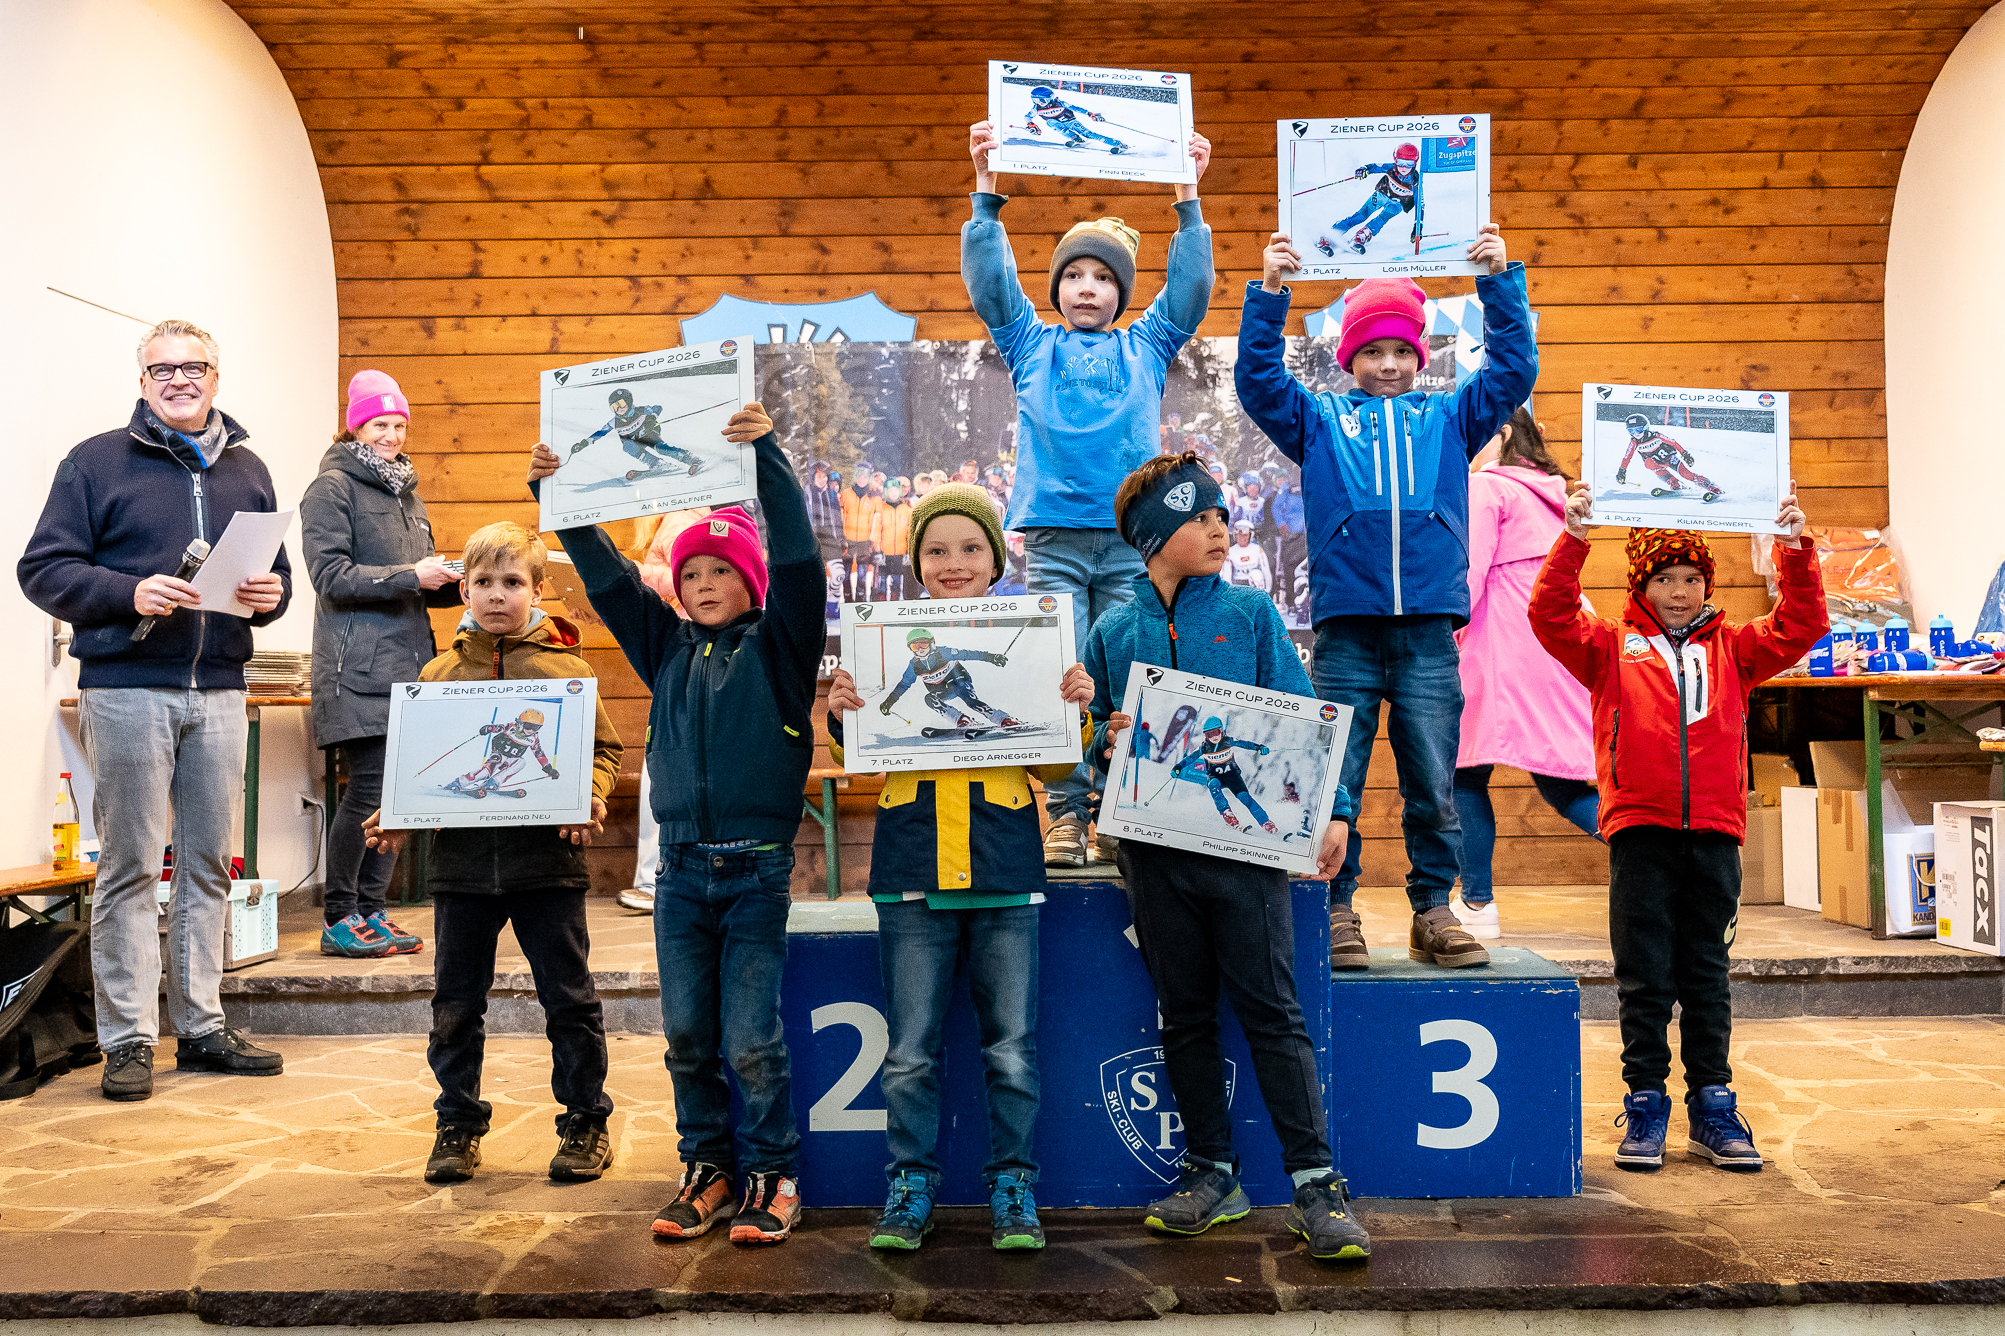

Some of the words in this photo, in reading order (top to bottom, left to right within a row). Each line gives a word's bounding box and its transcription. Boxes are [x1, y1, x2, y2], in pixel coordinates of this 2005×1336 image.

[1039, 68, 1080, 77] ZIENER
[1084, 72, 1109, 80] CUP
[1331, 125, 1374, 133] ZIENER
[1378, 124, 1404, 132] CUP
[592, 363, 634, 376] ZIENER
[638, 358, 664, 368] CUP
[667, 351, 700, 364] 2026
[1634, 392, 1676, 400] ZIENER
[1679, 394, 1704, 402] CUP
[1708, 395, 1739, 403] 2026
[641, 502, 668, 511] ANAN
[671, 495, 712, 506] SALFNER
[574, 512, 601, 521] PLATZ
[898, 607, 945, 616] ZIENER
[950, 605, 978, 613] CUP
[982, 603, 1017, 612] 2026
[1186, 681, 1231, 697] ZIENER
[1236, 690, 1262, 703] CUP
[1265, 697, 1300, 711] 2026
[1134, 828, 1163, 838] PLATZ
[1203, 841, 1238, 853] PHILIPP
[1240, 848, 1280, 862] SKINNER
[1974, 825, 1990, 936] Tacx
[810, 1002, 890, 1132] 2
[1130, 1071, 1158, 1111] S
[1417, 1019, 1500, 1150] 3
